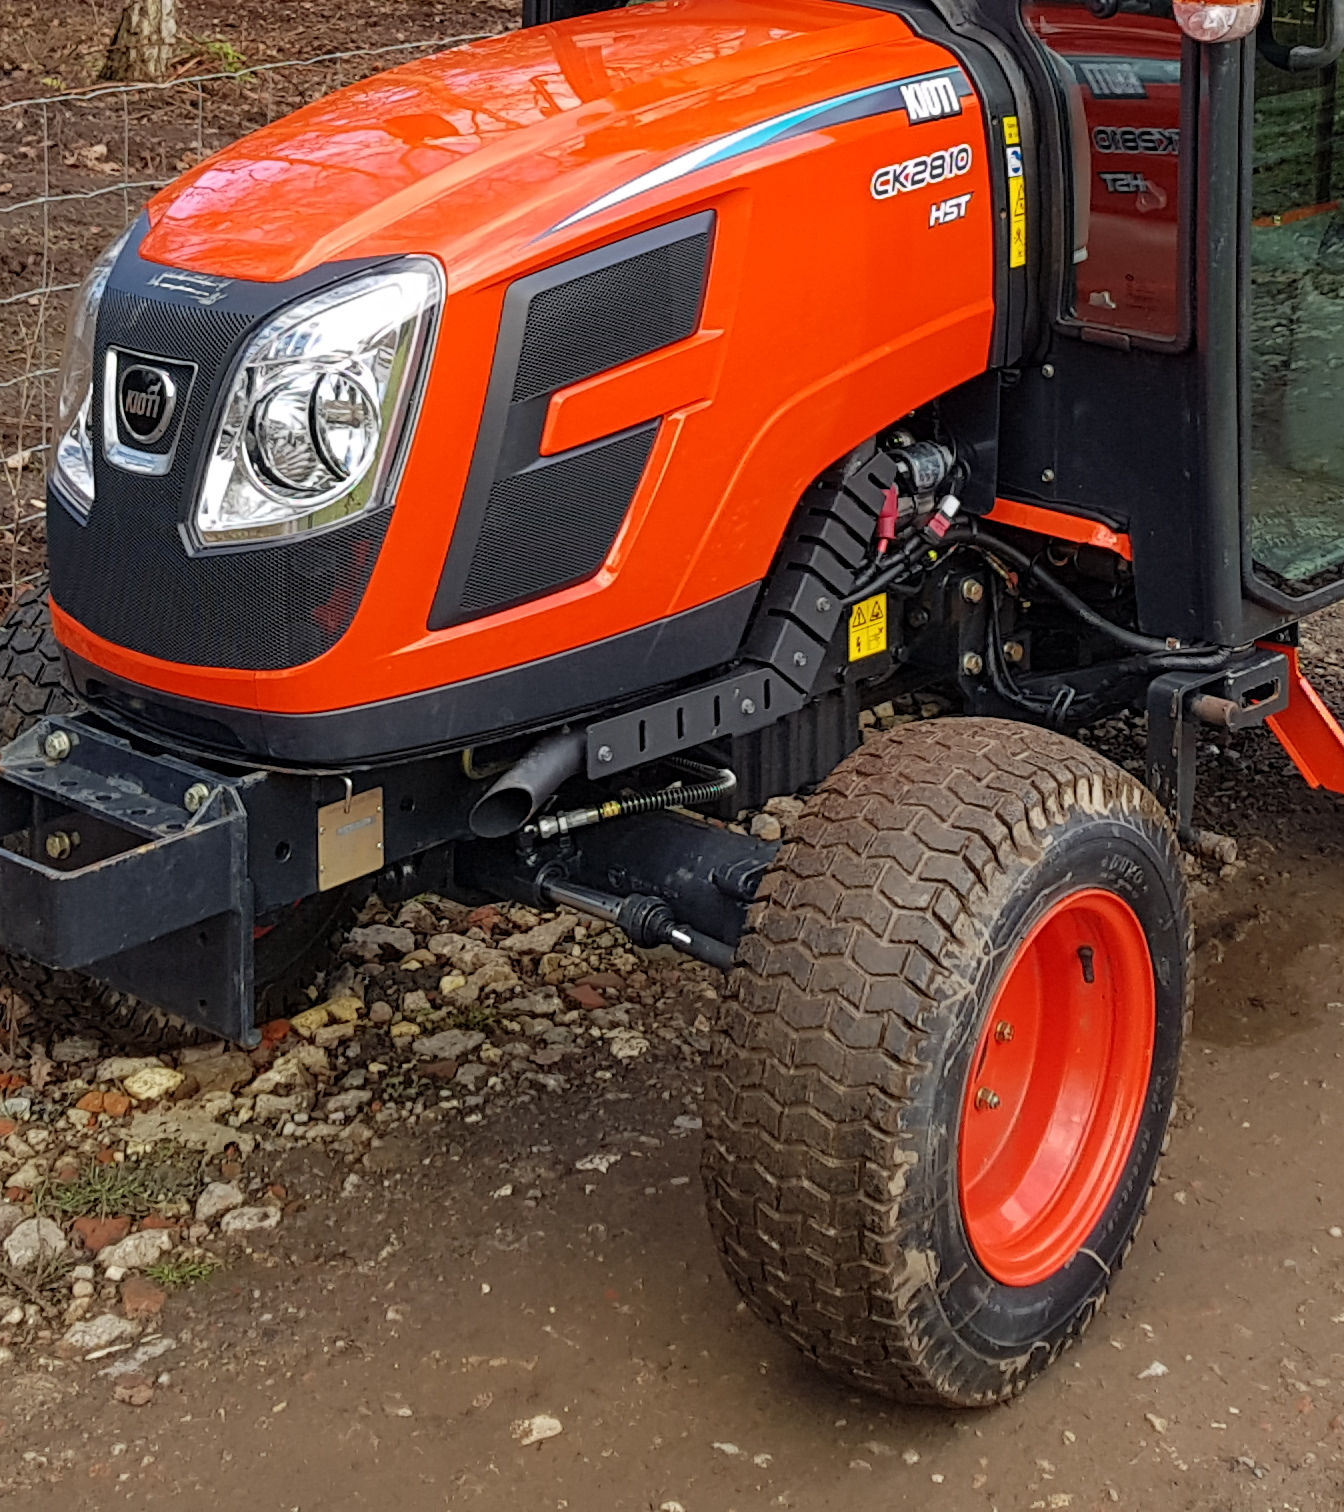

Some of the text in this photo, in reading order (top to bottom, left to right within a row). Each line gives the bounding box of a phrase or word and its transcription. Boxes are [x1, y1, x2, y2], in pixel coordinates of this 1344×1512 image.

[900, 77, 960, 120] KIOTI
[871, 144, 972, 200] CK2810
[928, 192, 974, 228] HST
[125, 389, 161, 419] KIOTI
